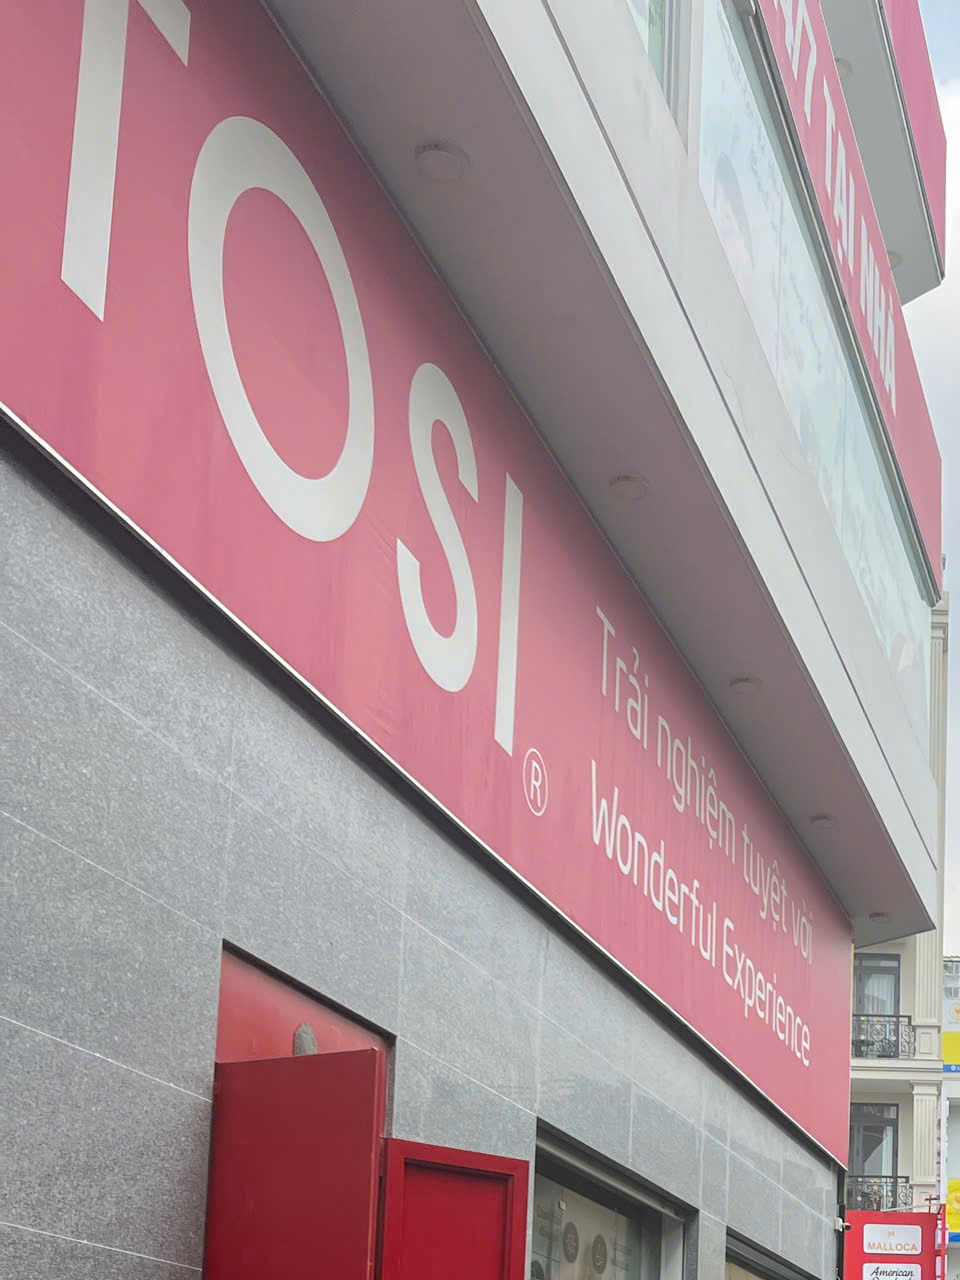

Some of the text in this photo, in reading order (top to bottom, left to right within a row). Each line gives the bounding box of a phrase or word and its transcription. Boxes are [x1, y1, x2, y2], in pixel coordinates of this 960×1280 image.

[823, 76, 855, 277] TẠI
[859, 215, 897, 417] NHÀ
[591, 760, 811, 1067] Wonderful Experience
[596, 605, 649, 750] Trải
[656, 713, 736, 863] nghiệm
[741, 823, 788, 934] tuyệt
[867, 1242, 918, 1252] MALLOCA
[870, 1266, 914, 1278] American
